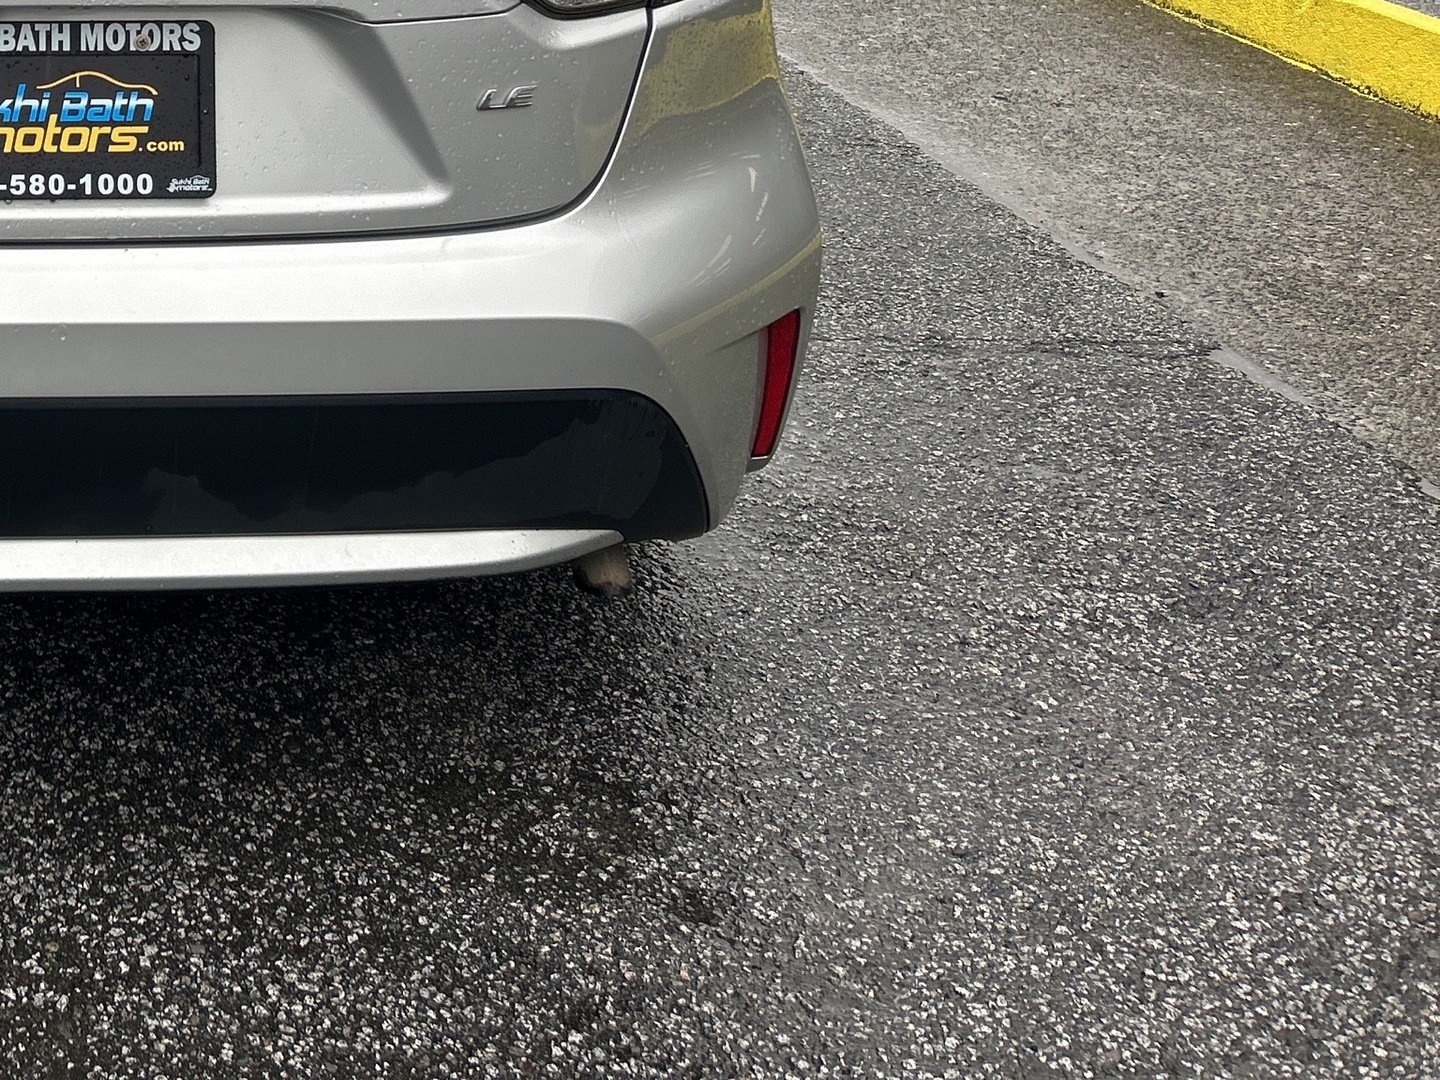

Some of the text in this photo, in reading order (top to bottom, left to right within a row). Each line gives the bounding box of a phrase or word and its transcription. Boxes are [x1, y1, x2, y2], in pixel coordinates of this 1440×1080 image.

[80, 23, 202, 52] MOTORS
[59, 91, 155, 123] Bath
[476, 84, 537, 111] LE
